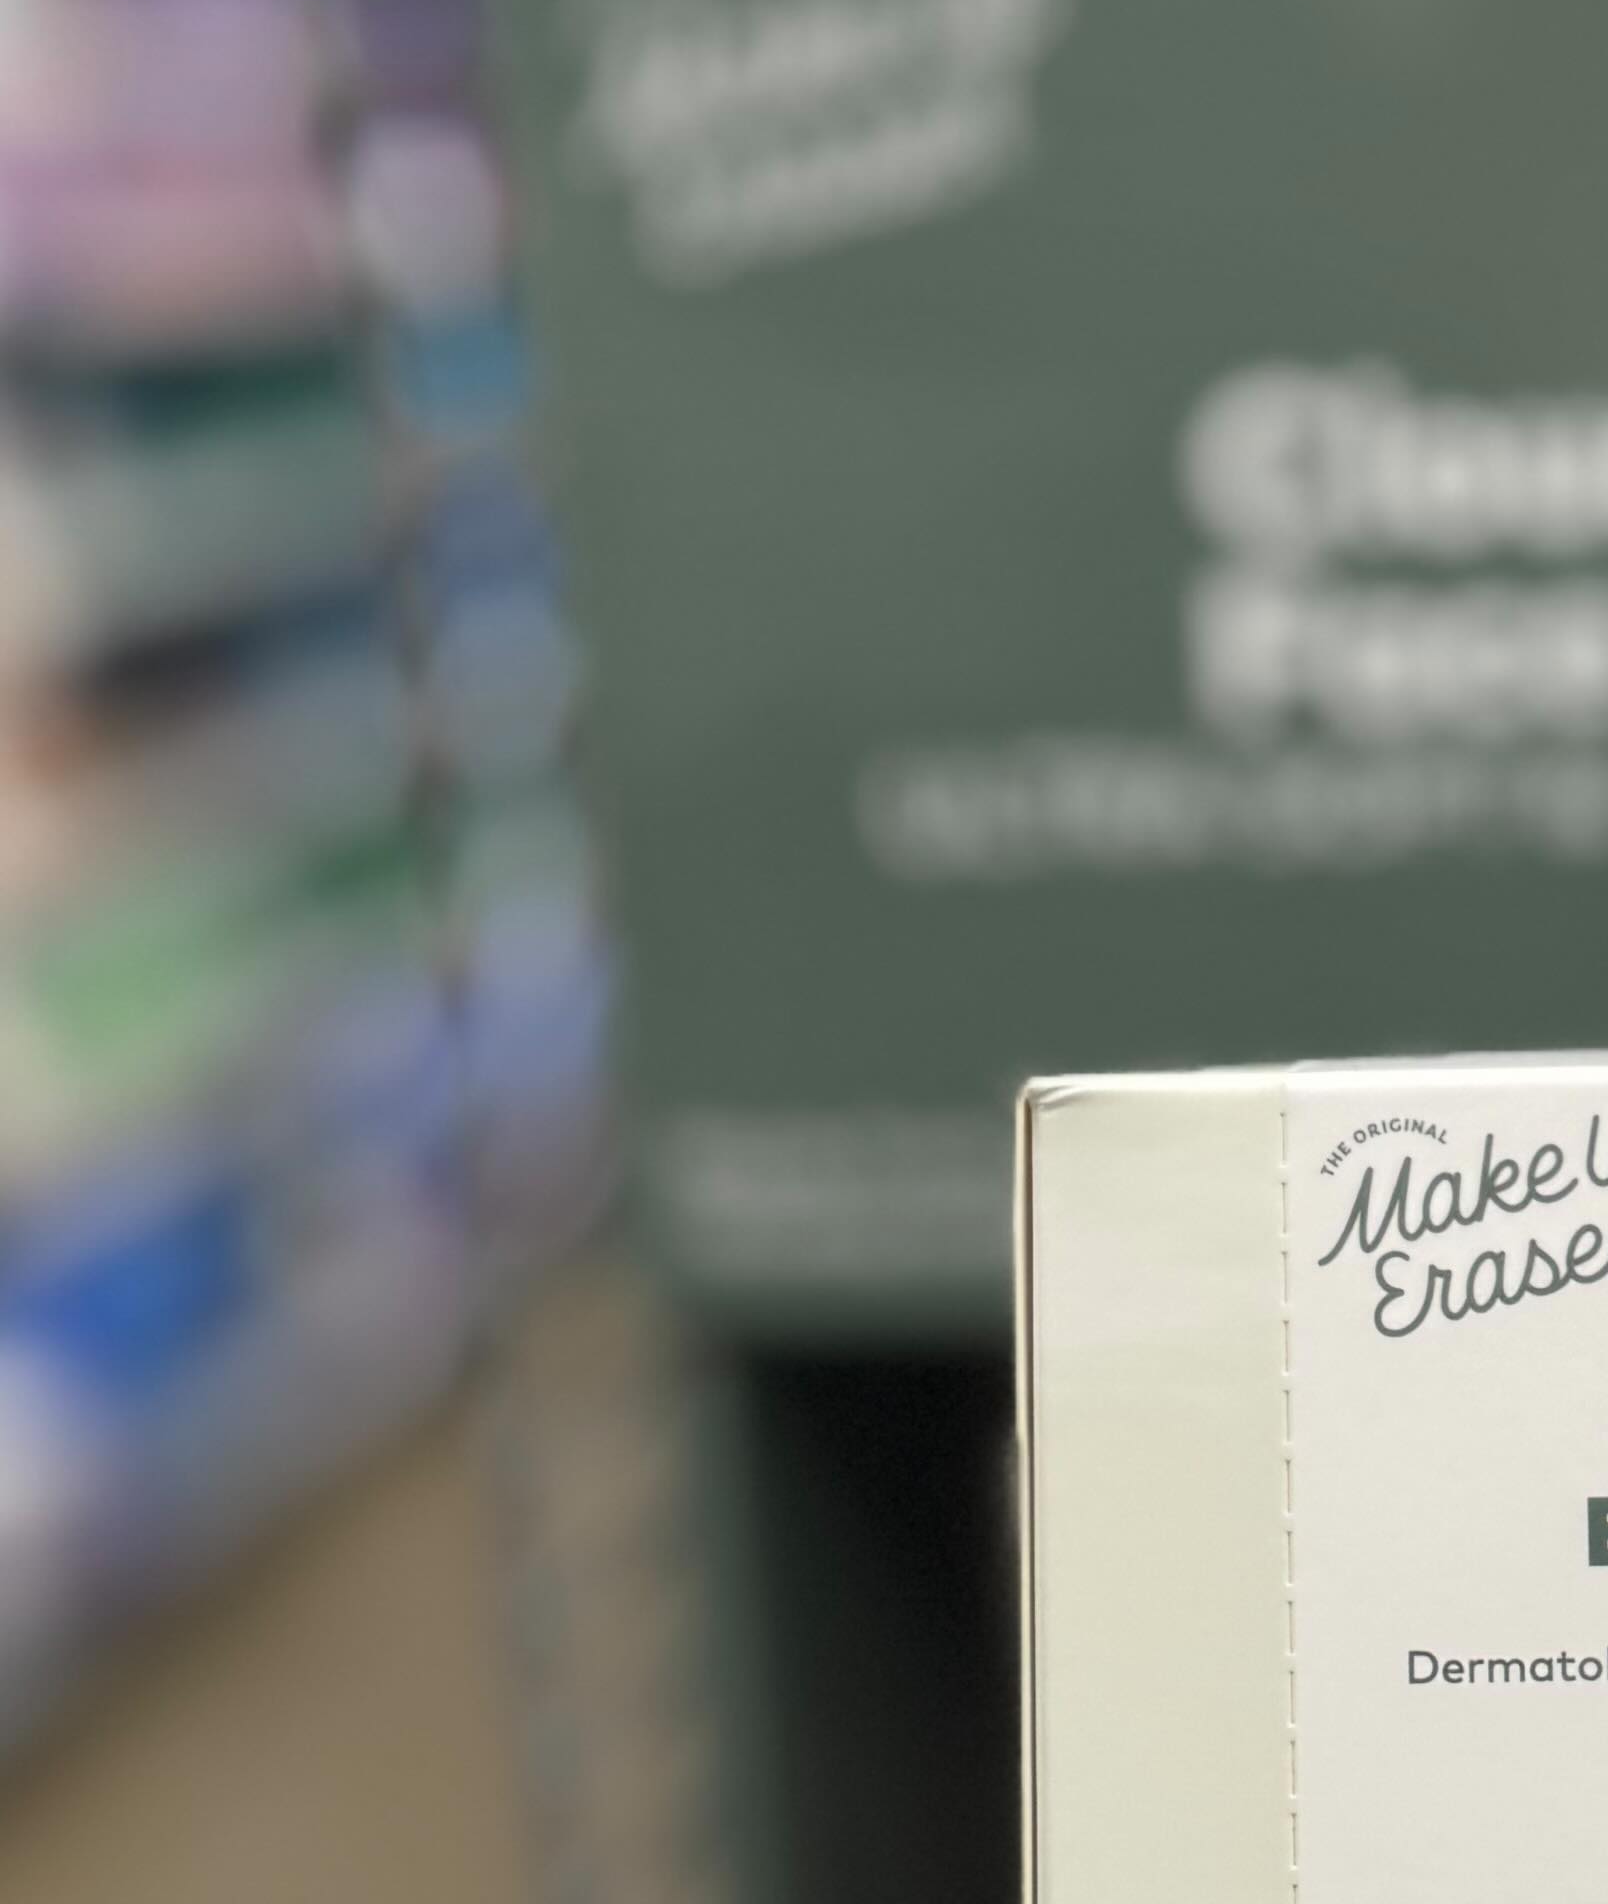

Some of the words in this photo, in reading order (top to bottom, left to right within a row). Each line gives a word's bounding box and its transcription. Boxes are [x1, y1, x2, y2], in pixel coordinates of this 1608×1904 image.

[1319, 1140, 1352, 1179] THE
[1352, 1116, 1450, 1146] ORIGINAL
[1317, 1132, 1580, 1268] Make
